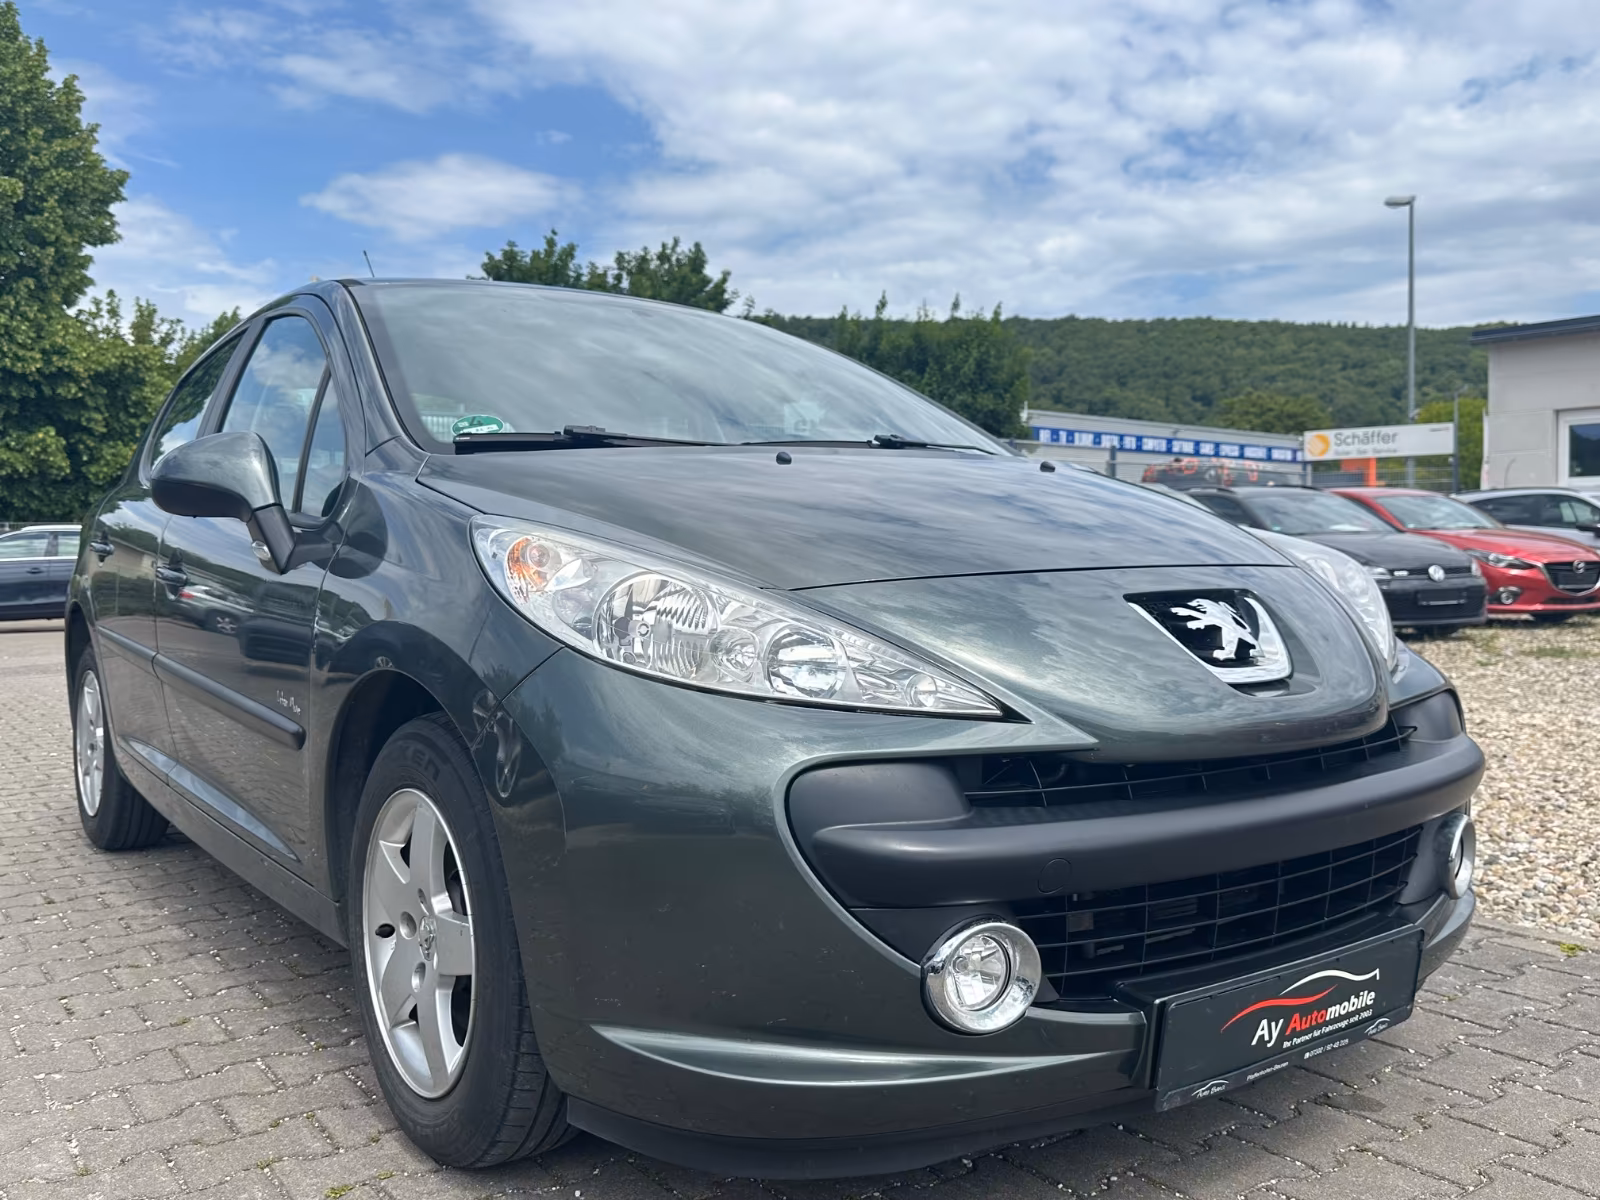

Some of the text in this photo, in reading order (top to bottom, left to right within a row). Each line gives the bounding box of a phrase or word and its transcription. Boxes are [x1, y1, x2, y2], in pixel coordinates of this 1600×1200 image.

[1334, 429, 1399, 447] Schäffer
[1251, 990, 1376, 1048] Ay Automobile
[1282, 1041, 1292, 1049] Ihr
[1292, 1033, 1313, 1046] Partner
[1312, 1029, 1322, 1038] für
[1321, 1018, 1350, 1034] Fahrzeuge
[1358, 1009, 1373, 1020] 2003
